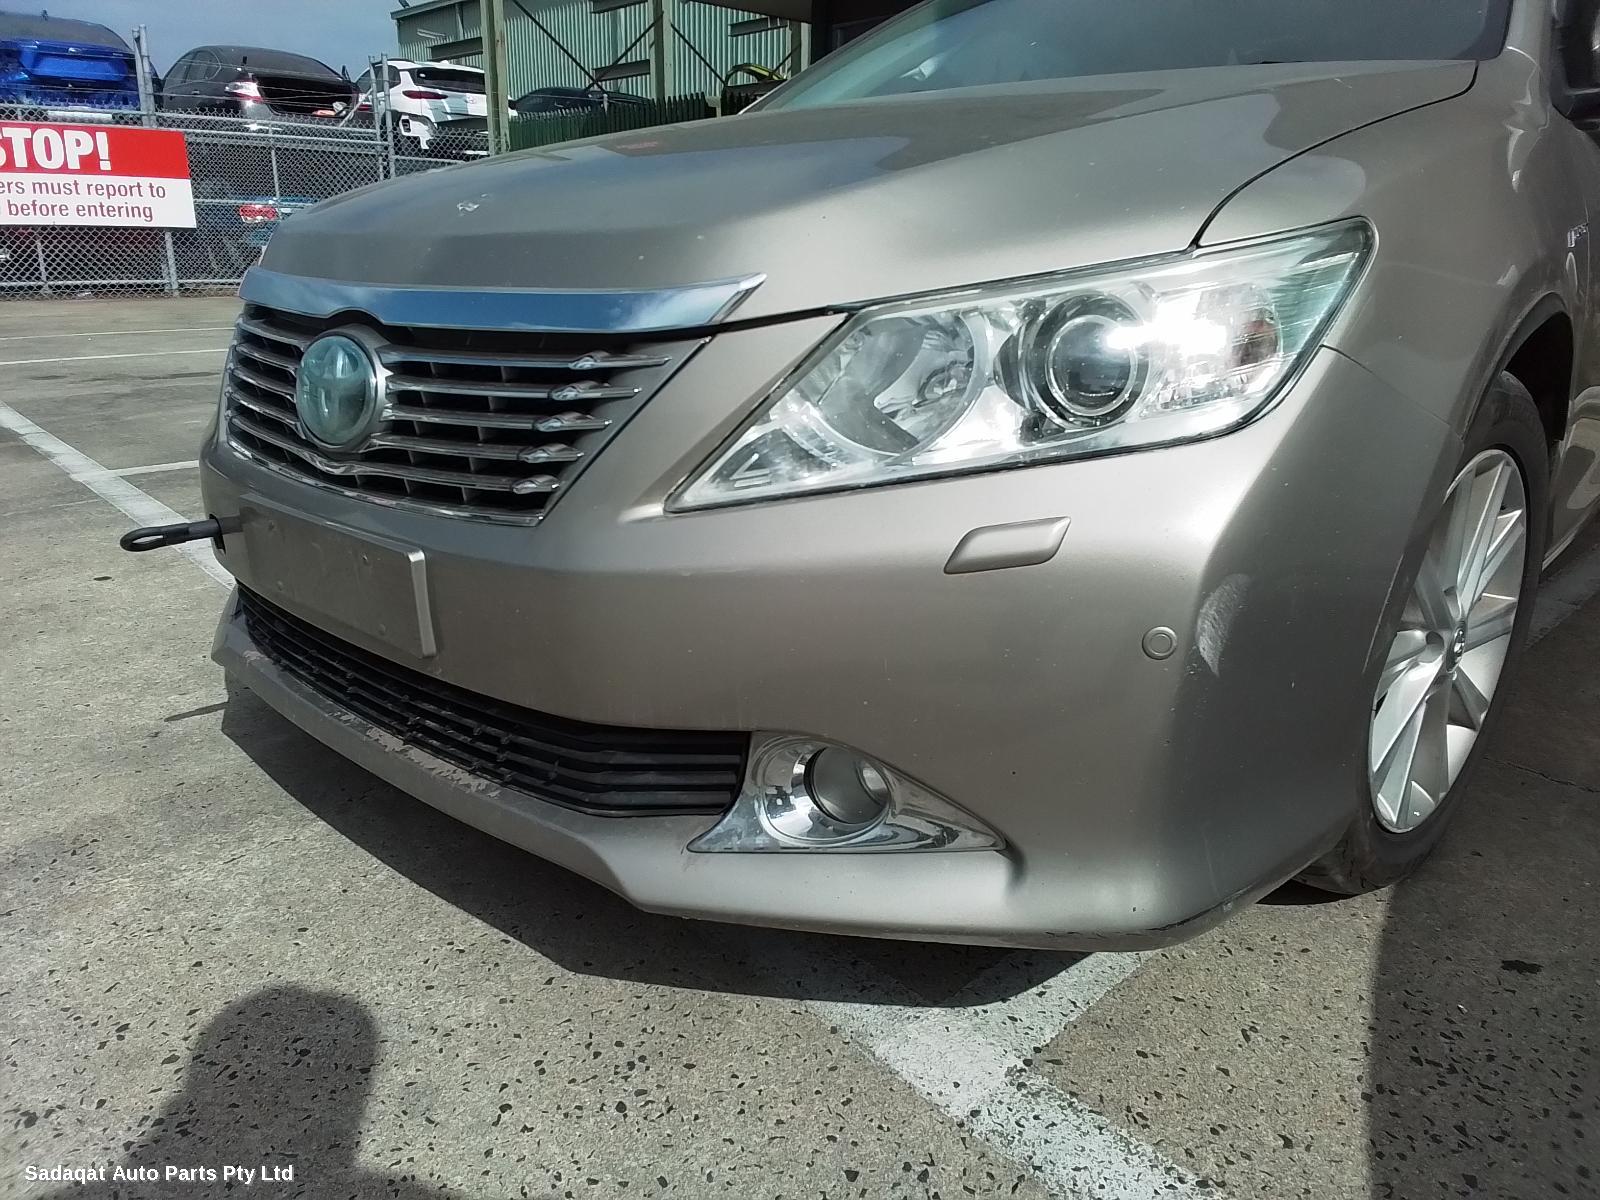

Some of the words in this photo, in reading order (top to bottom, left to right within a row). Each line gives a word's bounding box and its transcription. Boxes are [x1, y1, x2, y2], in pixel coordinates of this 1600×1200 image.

[32, 180, 80, 195] must
[87, 182, 143, 199] report
[148, 182, 166, 198] to
[7, 199, 69, 217] before
[76, 202, 154, 222] entering
